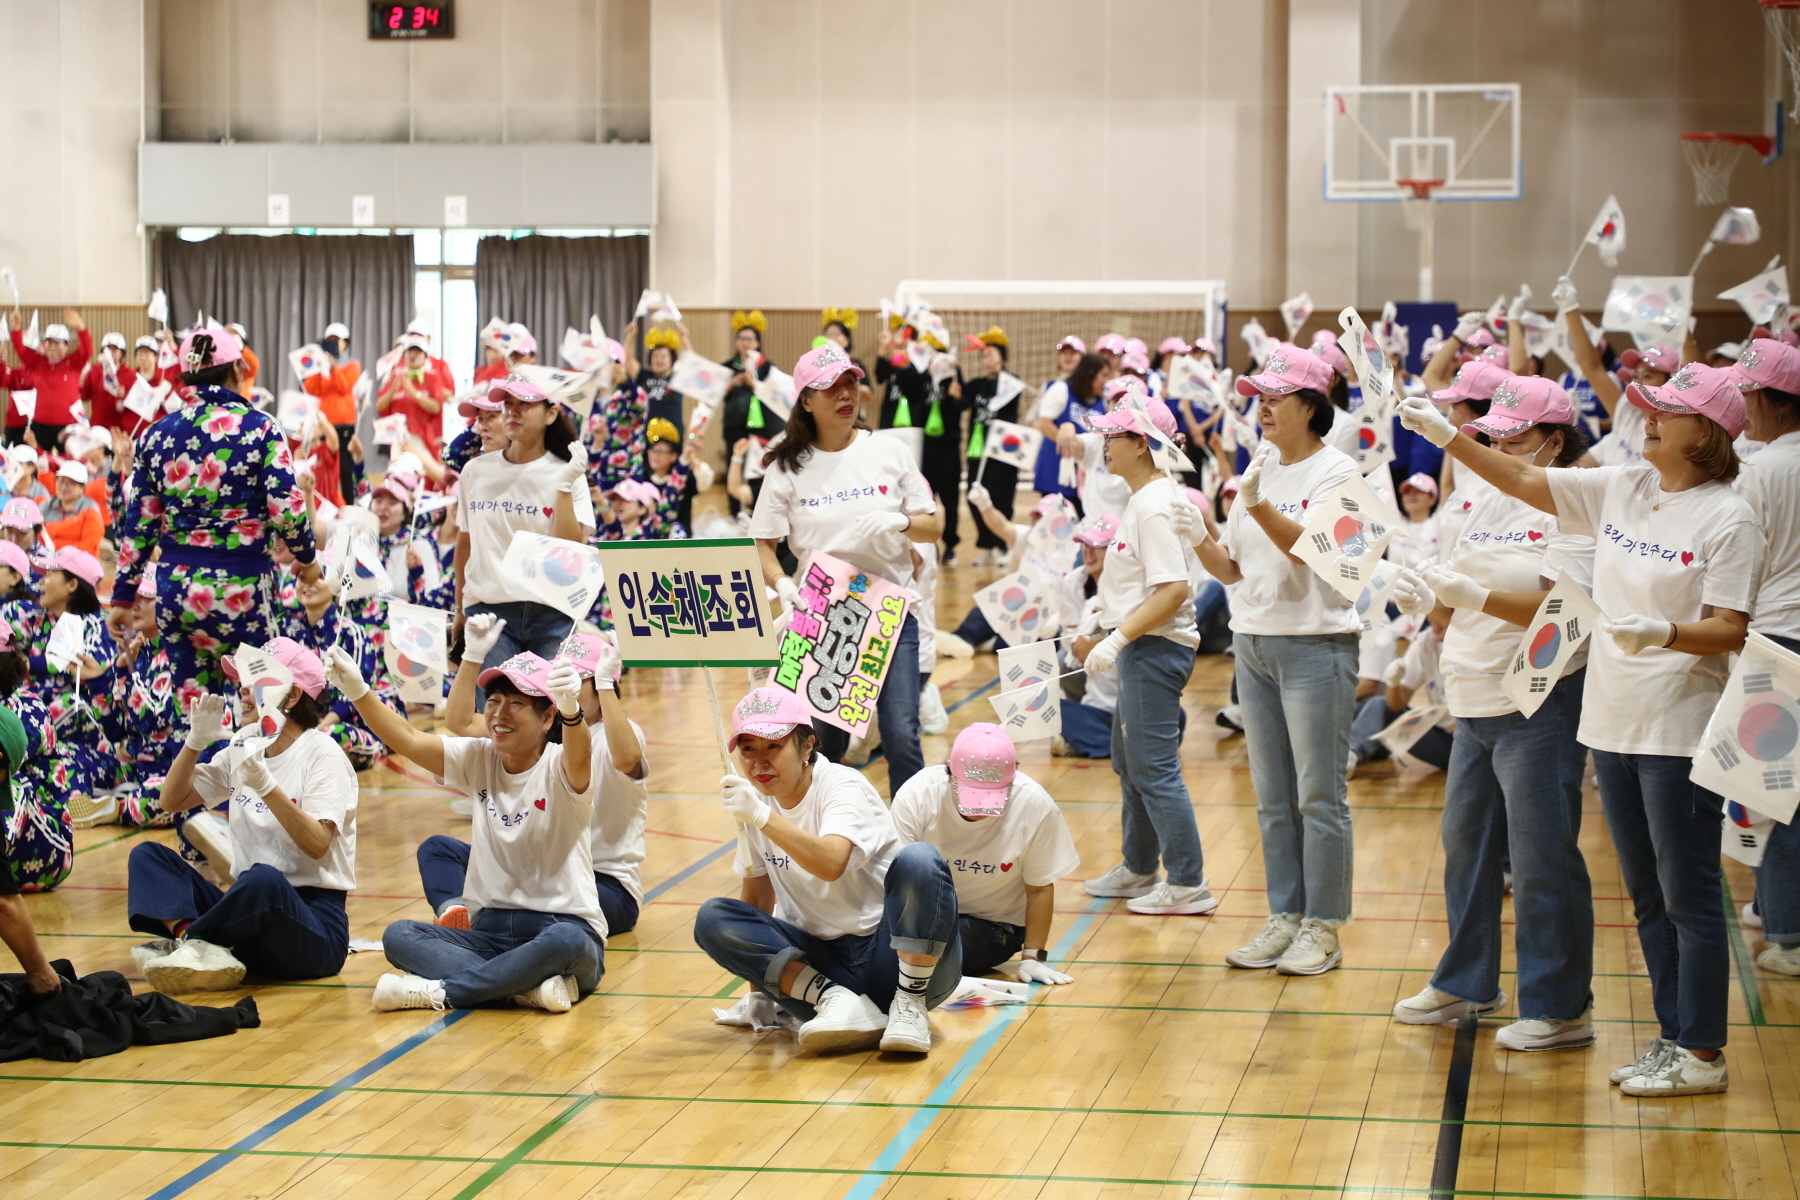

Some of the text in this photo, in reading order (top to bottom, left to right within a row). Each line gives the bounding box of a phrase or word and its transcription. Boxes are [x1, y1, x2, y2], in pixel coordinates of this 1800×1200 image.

[389, 6, 439, 29] 2 34
[470, 500, 539, 516] 우리가 인수다
[800, 486, 875, 510] 우리가 인수다
[1604, 524, 1678, 562] 우리가 인수다
[618, 569, 764, 638] 인수체조회
[839, 675, 879, 728] 완전
[953, 859, 997, 875] 인수다
